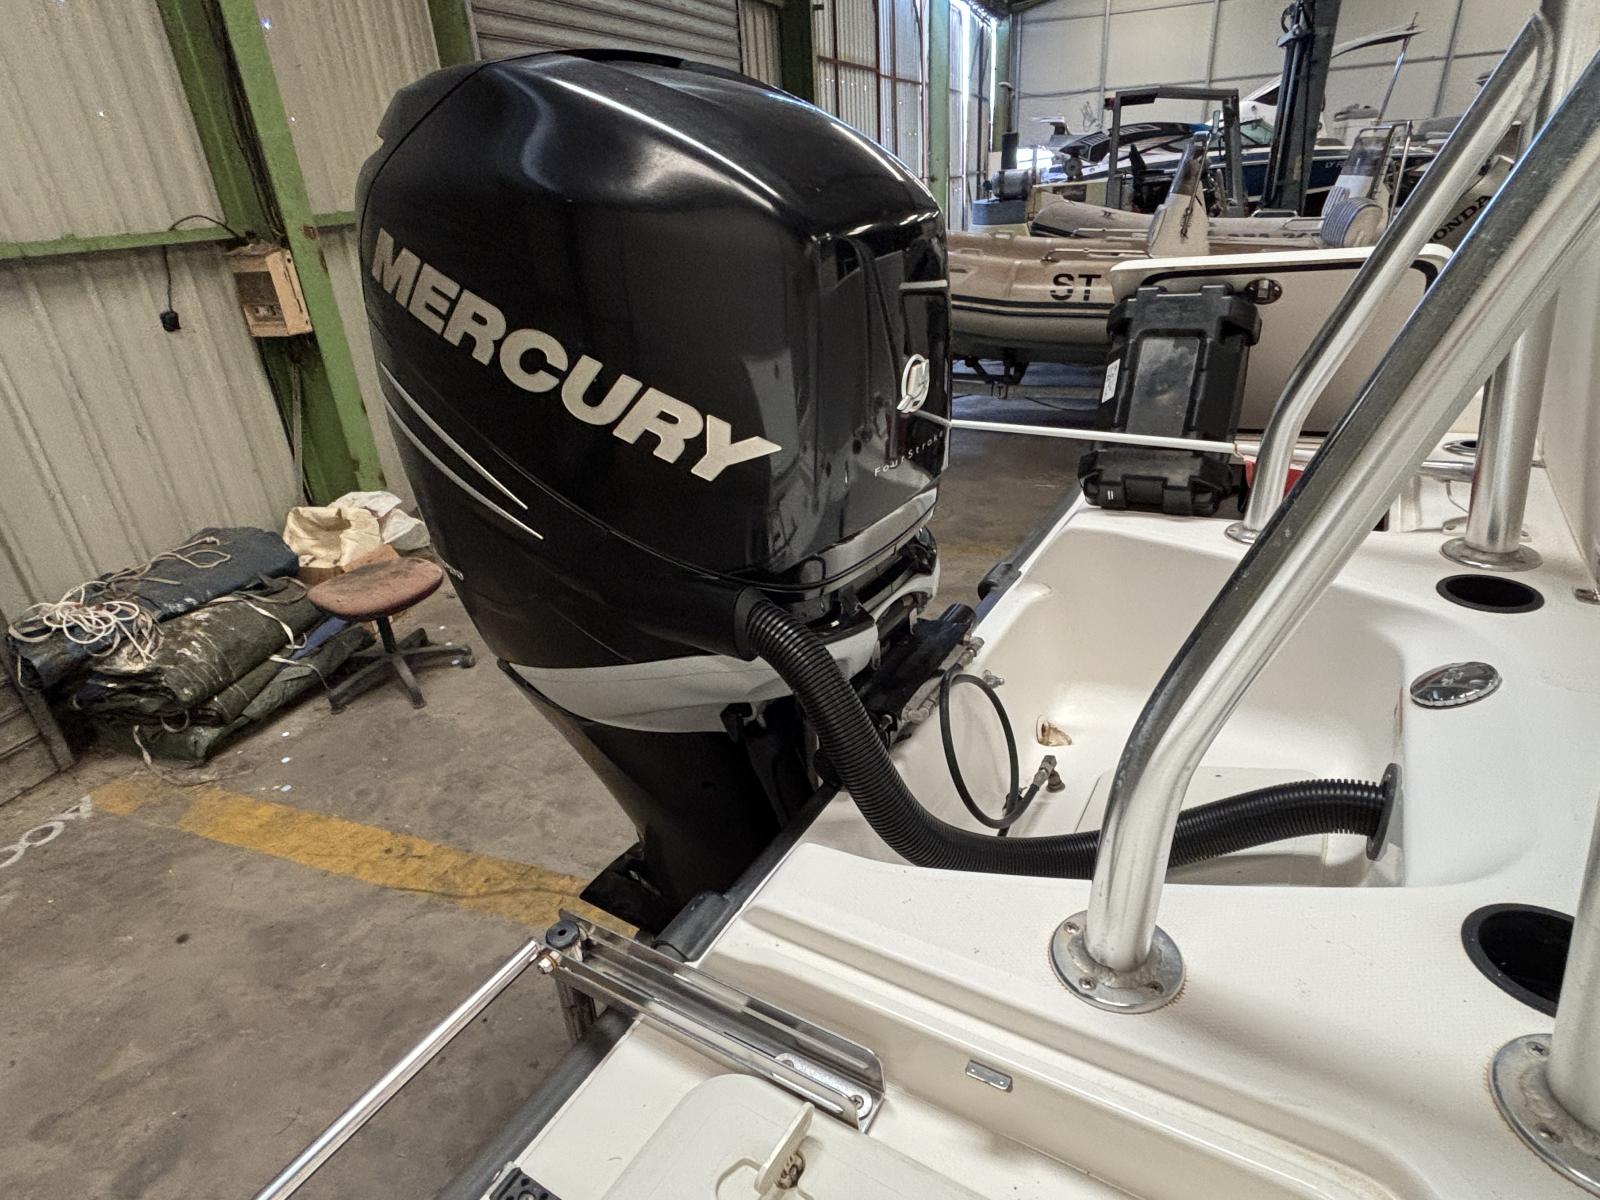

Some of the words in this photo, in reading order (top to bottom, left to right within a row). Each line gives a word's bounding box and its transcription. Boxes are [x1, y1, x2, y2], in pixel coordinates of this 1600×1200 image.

[1428, 195, 1493, 243] ONDA
[1050, 273, 1102, 301] ST
[371, 227, 782, 481] MERCURY
